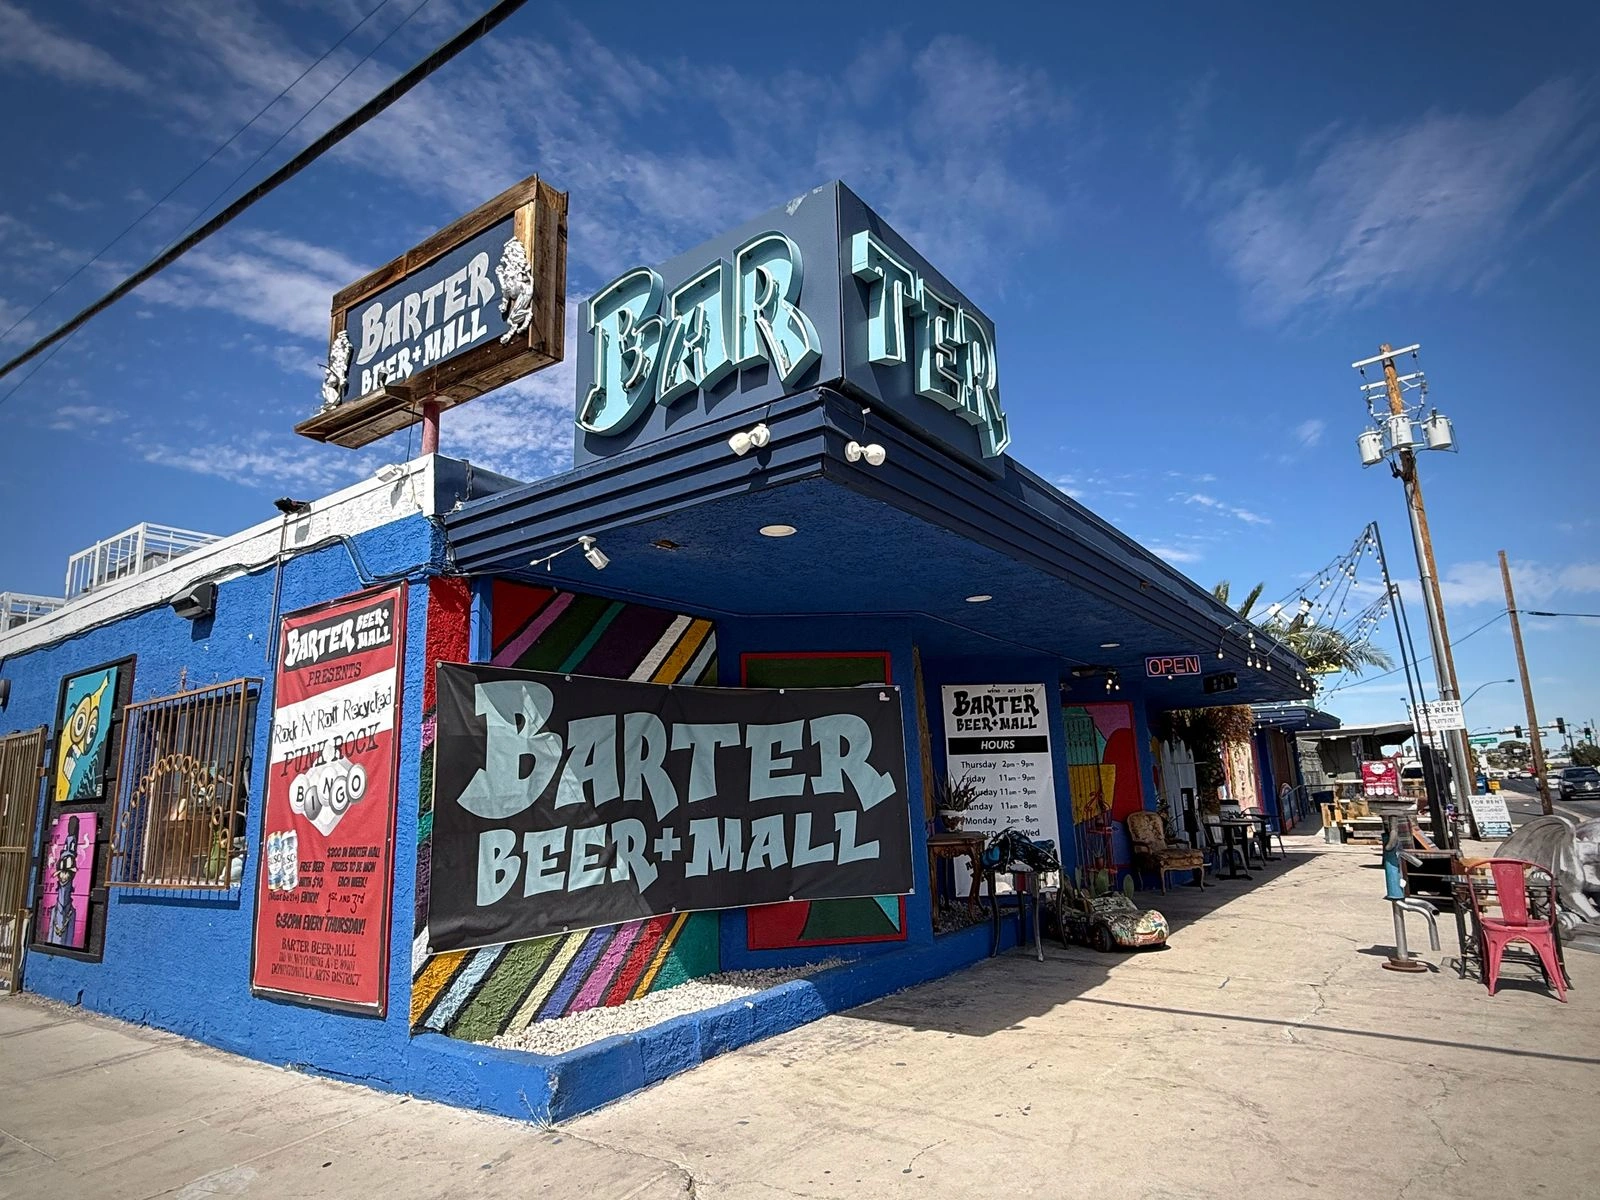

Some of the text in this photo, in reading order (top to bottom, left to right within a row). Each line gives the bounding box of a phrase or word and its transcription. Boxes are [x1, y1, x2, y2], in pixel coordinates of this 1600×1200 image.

[356, 252, 495, 365] BARTER
[284, 619, 355, 667] BARTER
[357, 626, 390, 649] MALL
[306, 661, 361, 687] PRESENTS
[1149, 657, 1197, 674] OPEN
[952, 690, 1040, 718] BARTER
[1435, 705, 1459, 714] RENT
[273, 720, 297, 744] Rock
[318, 706, 338, 730] Roll
[343, 686, 391, 721] Recycled
[281, 722, 380, 777] PUNK ROCK
[457, 680, 897, 822] BARTER
[981, 740, 1015, 750] HOURS
[961, 761, 997, 769] Thursday
[962, 775, 986, 783] Friday
[296, 775, 360, 810] BINGO
[969, 803, 993, 812] unday
[965, 817, 997, 825] Monday
[300, 861, 312, 872] FREE
[312, 861, 325, 872] BEER
[302, 915, 324, 931] EVERY
[325, 917, 366, 935] THURSDAY!
[282, 938, 309, 952] BARTER
[315, 968, 330, 981] ARTS
[331, 971, 362, 986] DISTRICT
